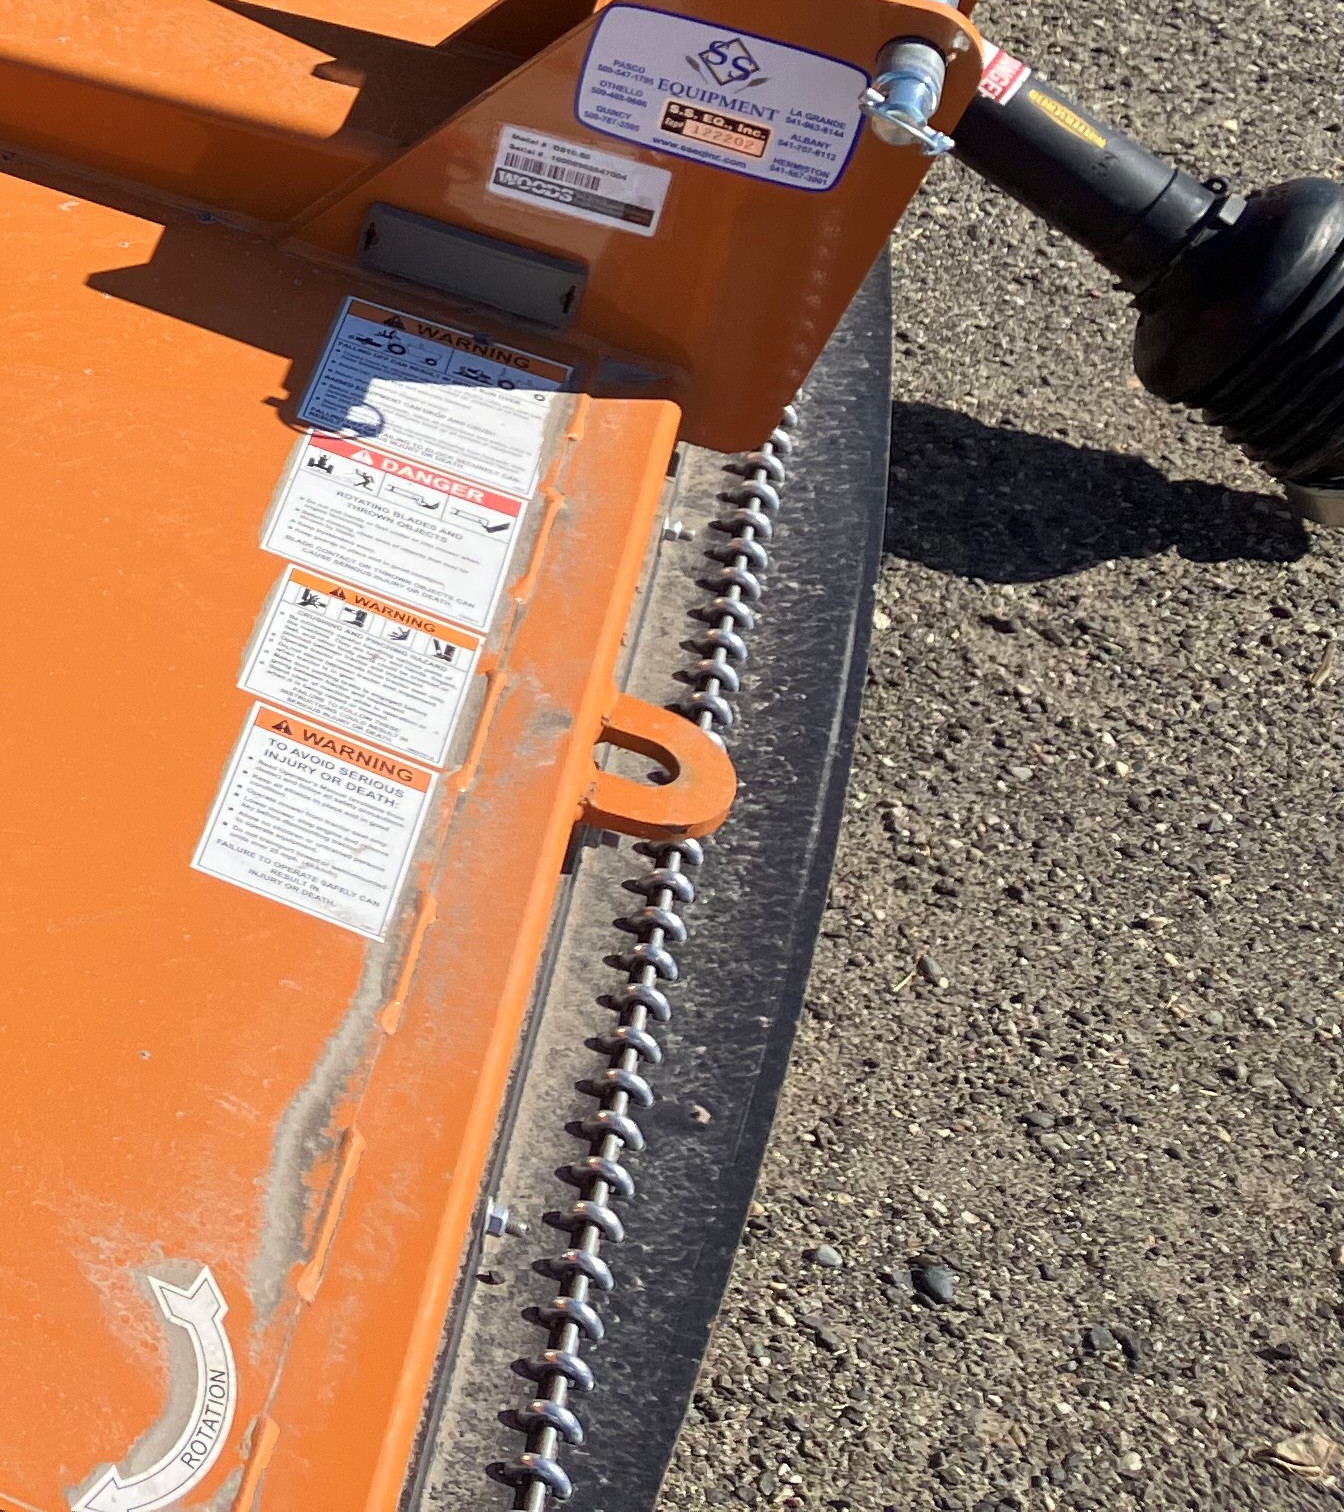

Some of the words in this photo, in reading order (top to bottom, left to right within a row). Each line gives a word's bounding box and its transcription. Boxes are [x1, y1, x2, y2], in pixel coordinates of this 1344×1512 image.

[612, 59, 645, 74] PASCO
[599, 79, 643, 97] OTHELLO
[656, 77, 780, 123] EQUIPMENT
[595, 104, 631, 120] QUINCY
[668, 103, 699, 119] S.S.
[737, 123, 767, 138] Inc.
[789, 108, 803, 117] LA
[804, 112, 847, 129] GRANDE
[691, 124, 755, 150] 122202
[790, 133, 831, 150] ALBANY
[495, 169, 575, 203] WOODS
[414, 323, 532, 370] WARNING
[379, 459, 485, 503] DANGER
[336, 490, 391, 513] ROTATING
[392, 510, 437, 530] BLADES
[439, 527, 463, 540] AND
[346, 502, 394, 523] THROWN
[396, 520, 448, 543] OBJECTS
[352, 594, 437, 633] WARNING
[263, 748, 316, 776] INJURY
[319, 771, 342, 786] OR
[267, 737, 288, 751] TO
[289, 746, 335, 770] AVOID
[338, 766, 405, 798] SERIOUS
[300, 728, 414, 783] WARNING
[216, 838, 256, 858] FAILURE
[258, 854, 272, 864] TO
[273, 860, 318, 883] OPERATE
[320, 879, 356, 898] SAFELY
[358, 894, 380, 907] CAN
[248, 868, 283, 885] INJURY
[284, 882, 299, 892] OR
[270, 868, 306, 886] RESULT
[308, 883, 319, 891] IN
[180, 1369, 226, 1470] ROTATION
